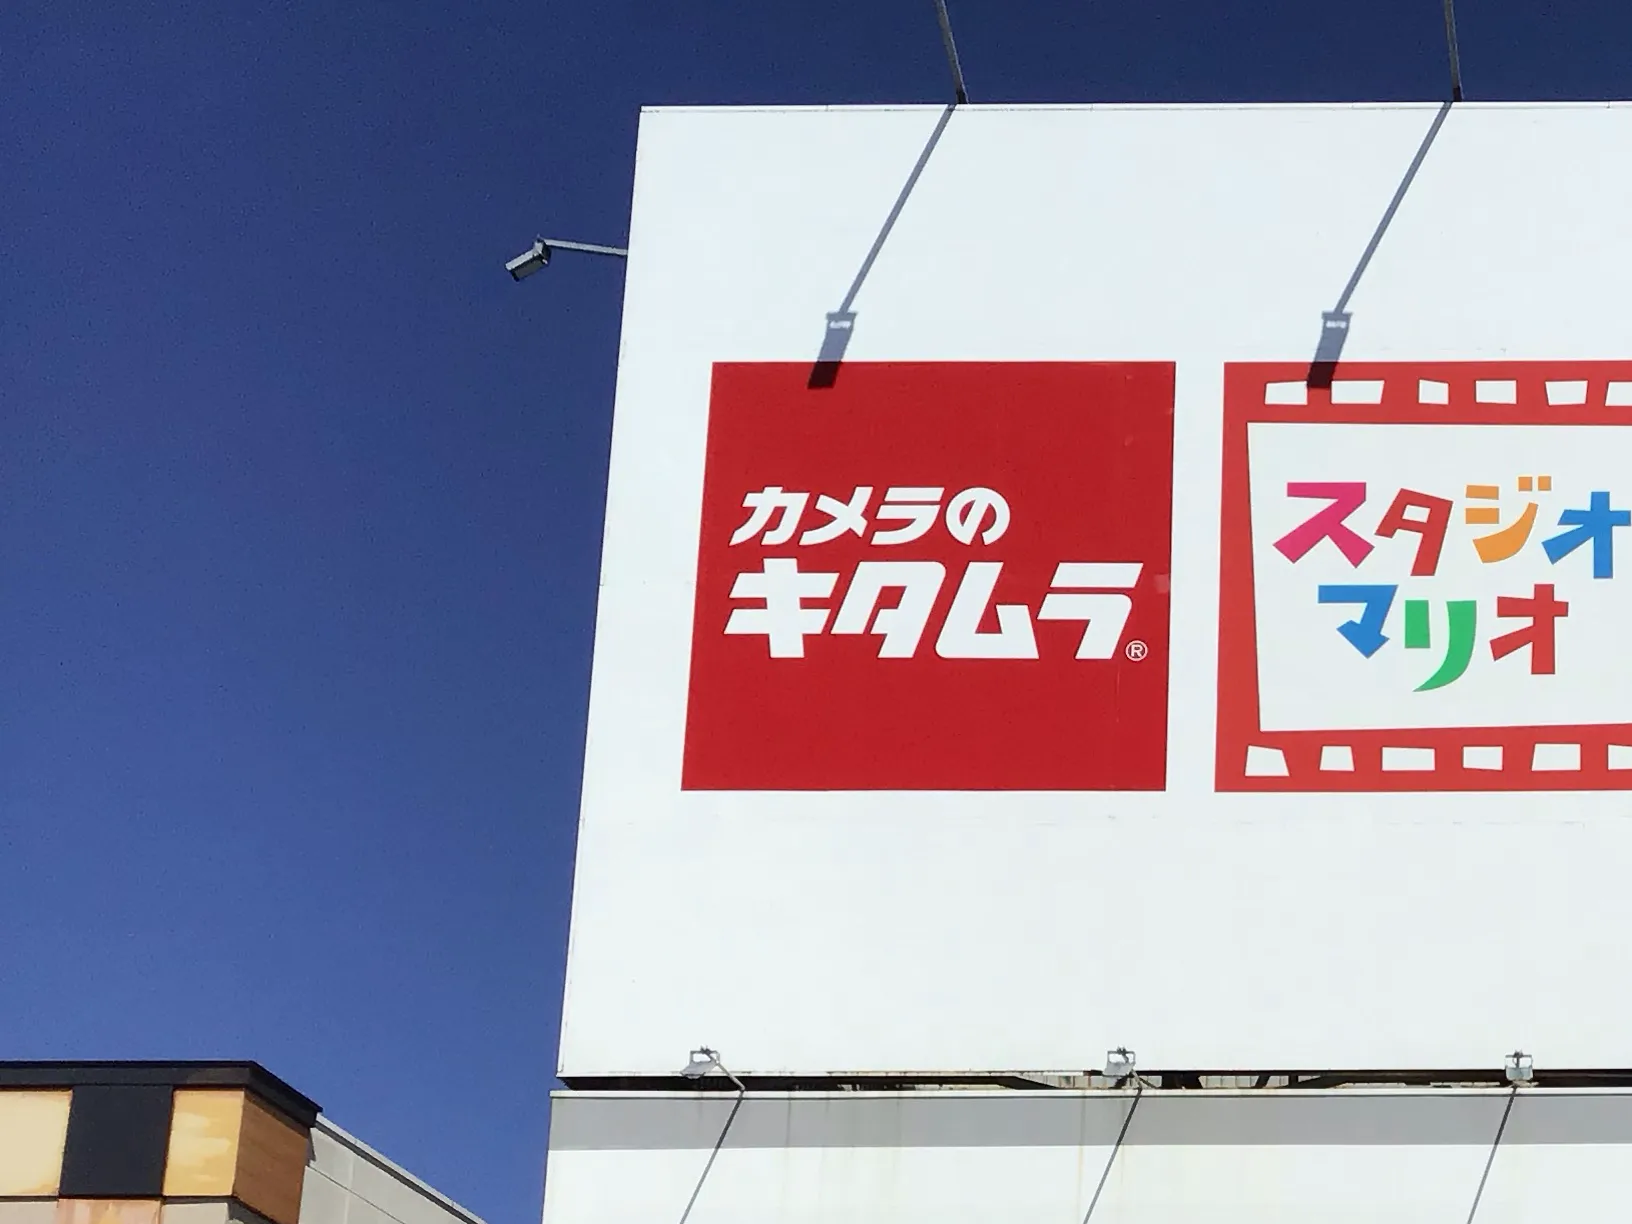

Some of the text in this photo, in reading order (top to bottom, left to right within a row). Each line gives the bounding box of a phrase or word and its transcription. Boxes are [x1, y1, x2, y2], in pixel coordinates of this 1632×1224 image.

[729, 486, 1011, 546] カメラの
[1273, 475, 1632, 579] スタジオ
[1317, 583, 1569, 692] マリオ
